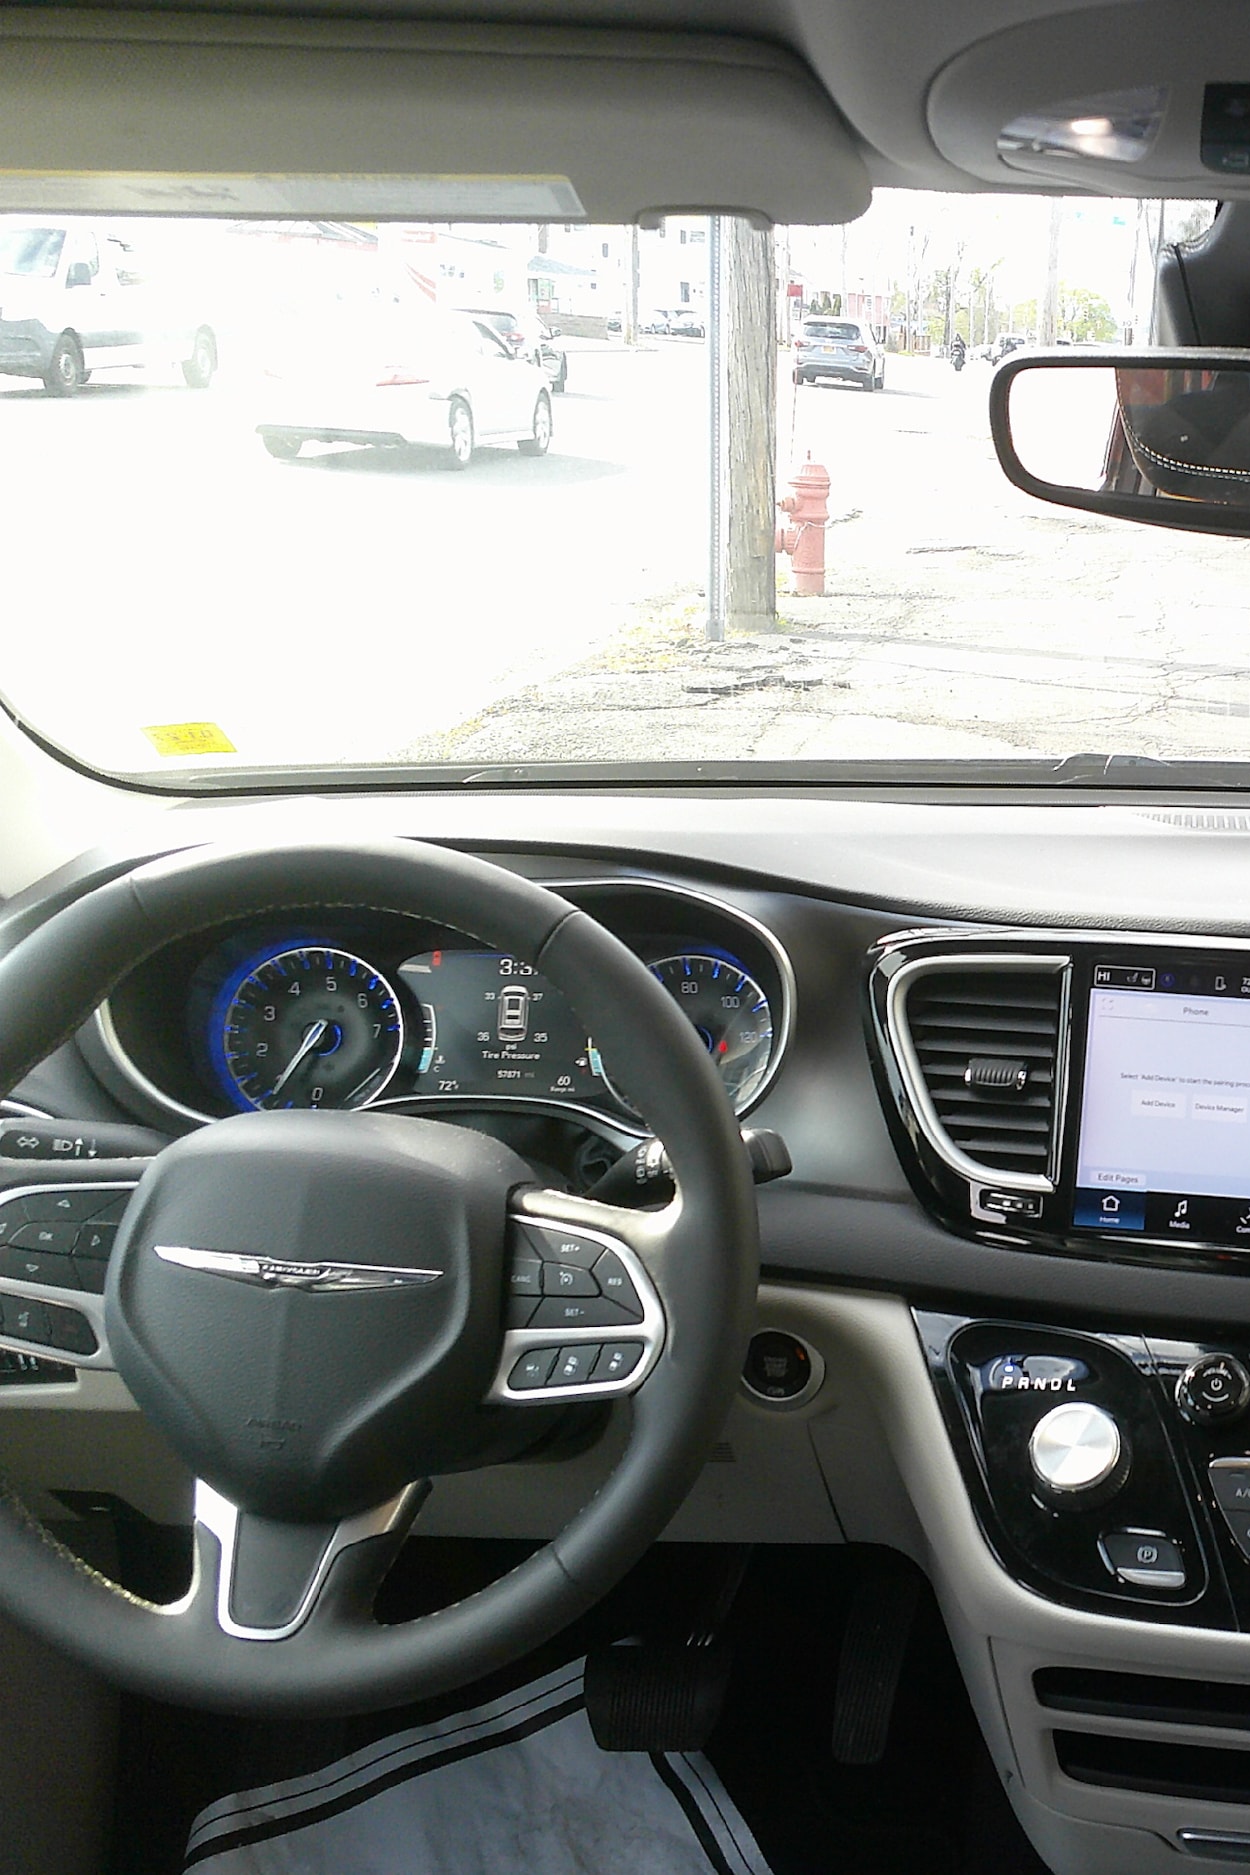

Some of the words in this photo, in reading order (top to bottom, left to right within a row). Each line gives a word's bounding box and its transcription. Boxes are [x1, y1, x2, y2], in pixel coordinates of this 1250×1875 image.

[499, 958, 538, 976] 3:3
[1097, 971, 1111, 982] HI
[288, 981, 301, 996] 4
[326, 976, 337, 992] 5
[681, 981, 698, 994] 80
[357, 993, 368, 1008] 6
[720, 996, 740, 1009] 100
[263, 1005, 276, 1021] 3
[1183, 1007, 1209, 1017] Phone
[372, 1023, 382, 1039] 7
[256, 1042, 269, 1057] 2
[482, 1050, 499, 1059] Tire
[500, 1051, 541, 1060] Pressure
[557, 1075, 571, 1086] 60
[311, 1087, 323, 1101] 0
[1141, 1099, 1154, 1107] Add
[1195, 1103, 1215, 1111] Device
[1216, 1104, 1244, 1113] Manager
[1097, 1173, 1114, 1182] Edit
[1115, 1174, 1139, 1184] Pages
[1099, 1216, 1121, 1224] Home
[1169, 1220, 1190, 1230] Media
